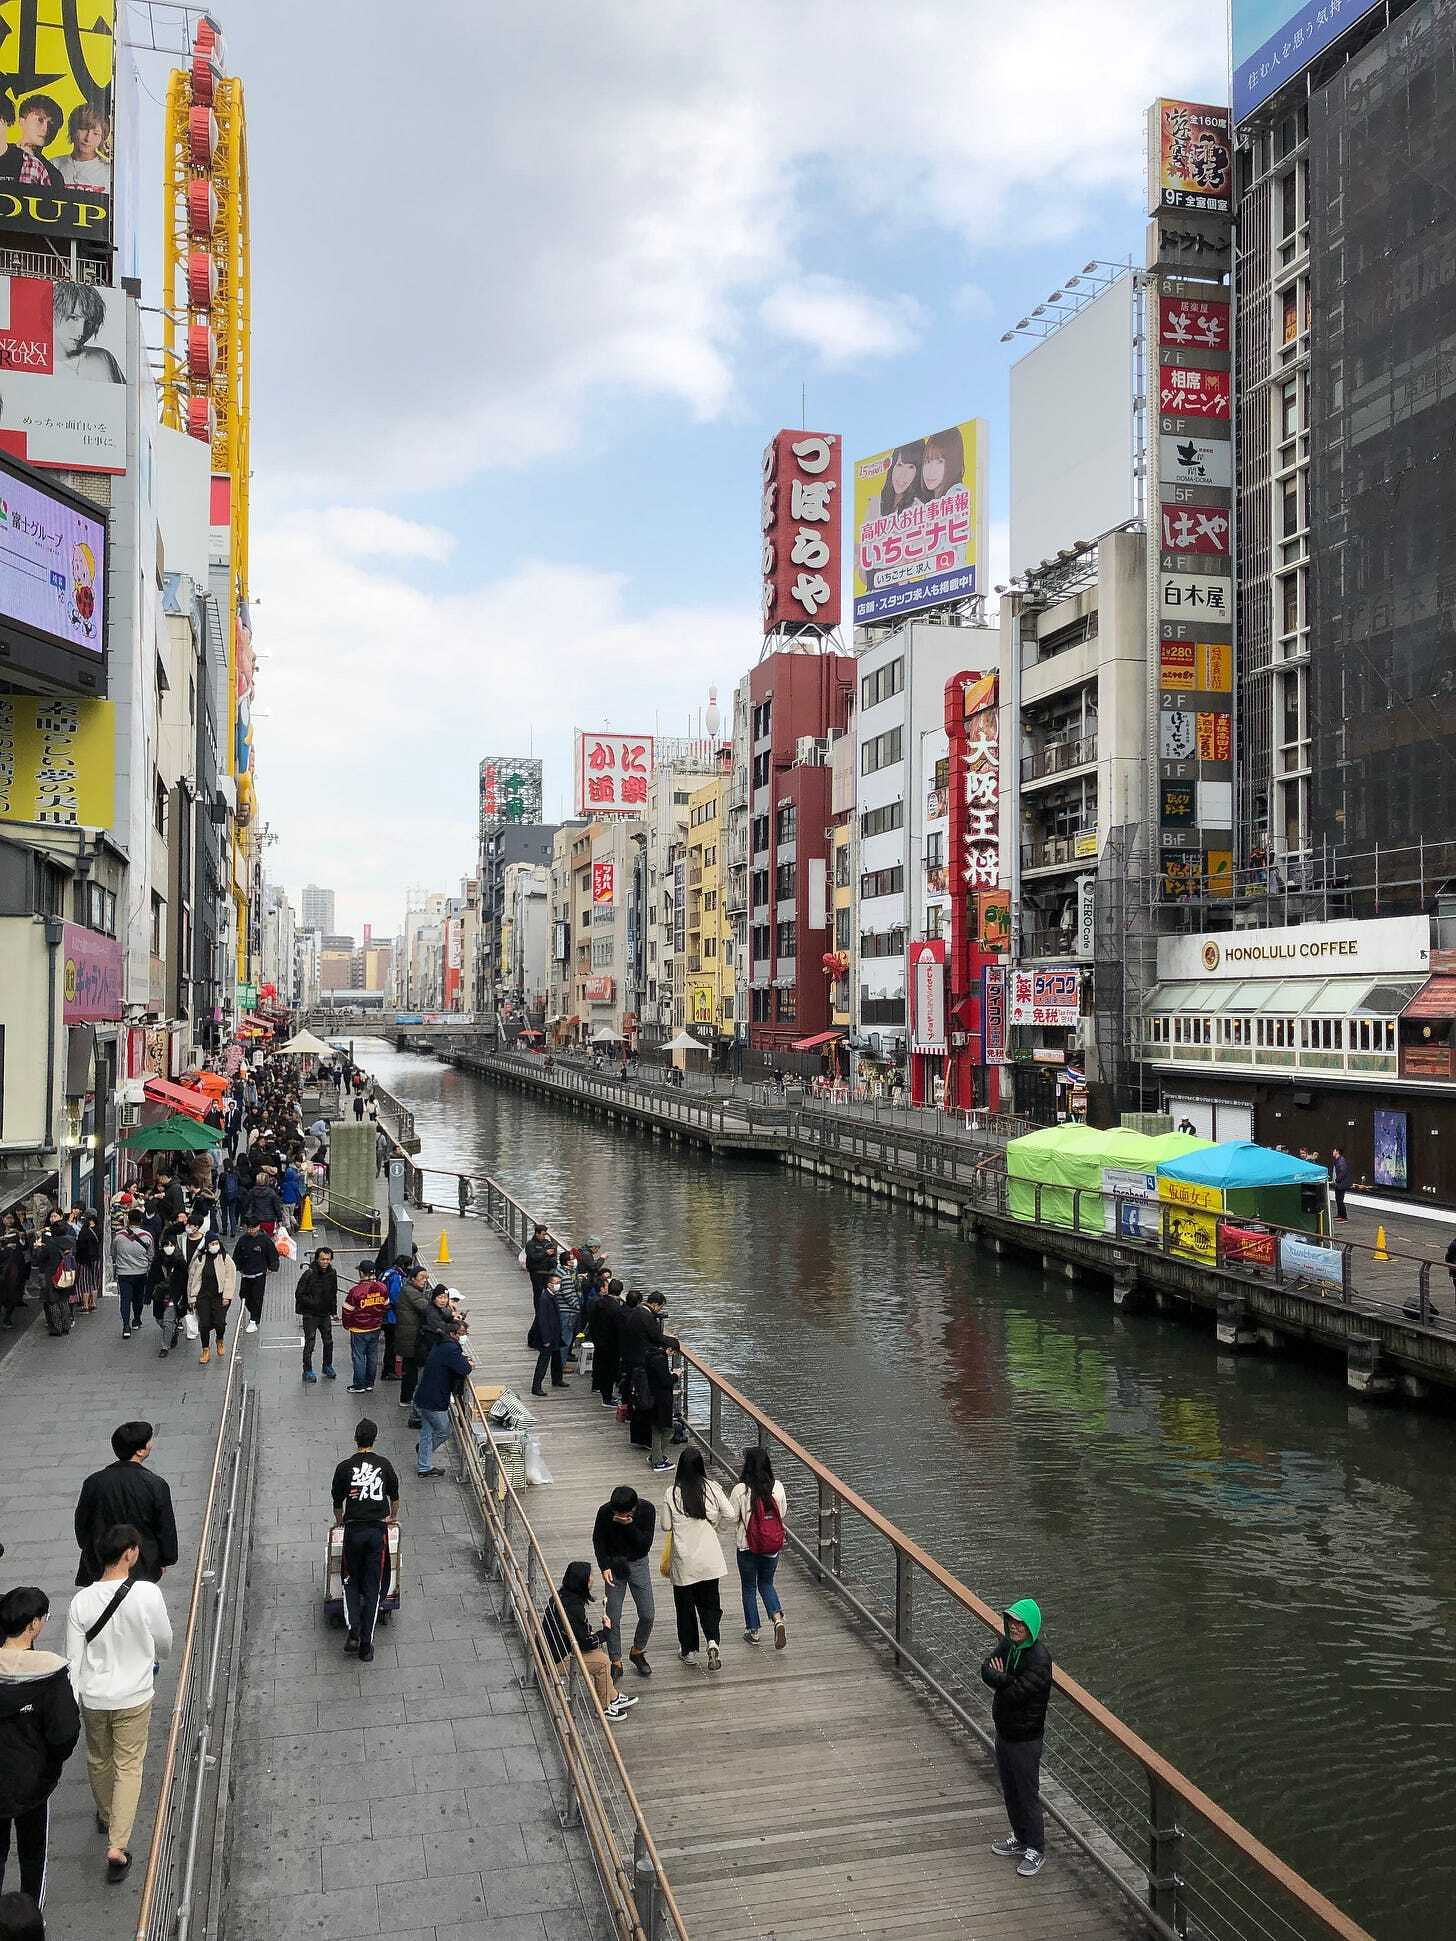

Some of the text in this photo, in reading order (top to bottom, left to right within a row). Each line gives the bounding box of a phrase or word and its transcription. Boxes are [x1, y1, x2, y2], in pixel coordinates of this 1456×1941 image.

[1165, 189, 1228, 210] 9F 全室個室
[1171, 370, 1201, 389] 相席
[1161, 389, 1229, 414] ダイニング
[1176, 488, 1193, 501] 5F
[862, 492, 969, 540] 高収入お仕事情報
[12, 511, 63, 547] 富士グループ
[861, 511, 969, 568] いちごナビ
[1163, 511, 1228, 550] はや
[876, 566, 914, 585] いちごナビ
[1164, 579, 1225, 609] 白木屋
[588, 742, 647, 772] かに
[960, 733, 1000, 887] 大阪王将
[594, 869, 602, 896] ドラッグ
[602, 865, 612, 890] ツルハ
[1225, 940, 1358, 961] HONOLULU COFFEE
[988, 967, 1004, 983] 薬
[1035, 976, 1076, 995] ダイコク
[1016, 974, 1032, 1003] 薬
[1033, 1008, 1059, 1023] 免税
[986, 1049, 1005, 1059] 免税
